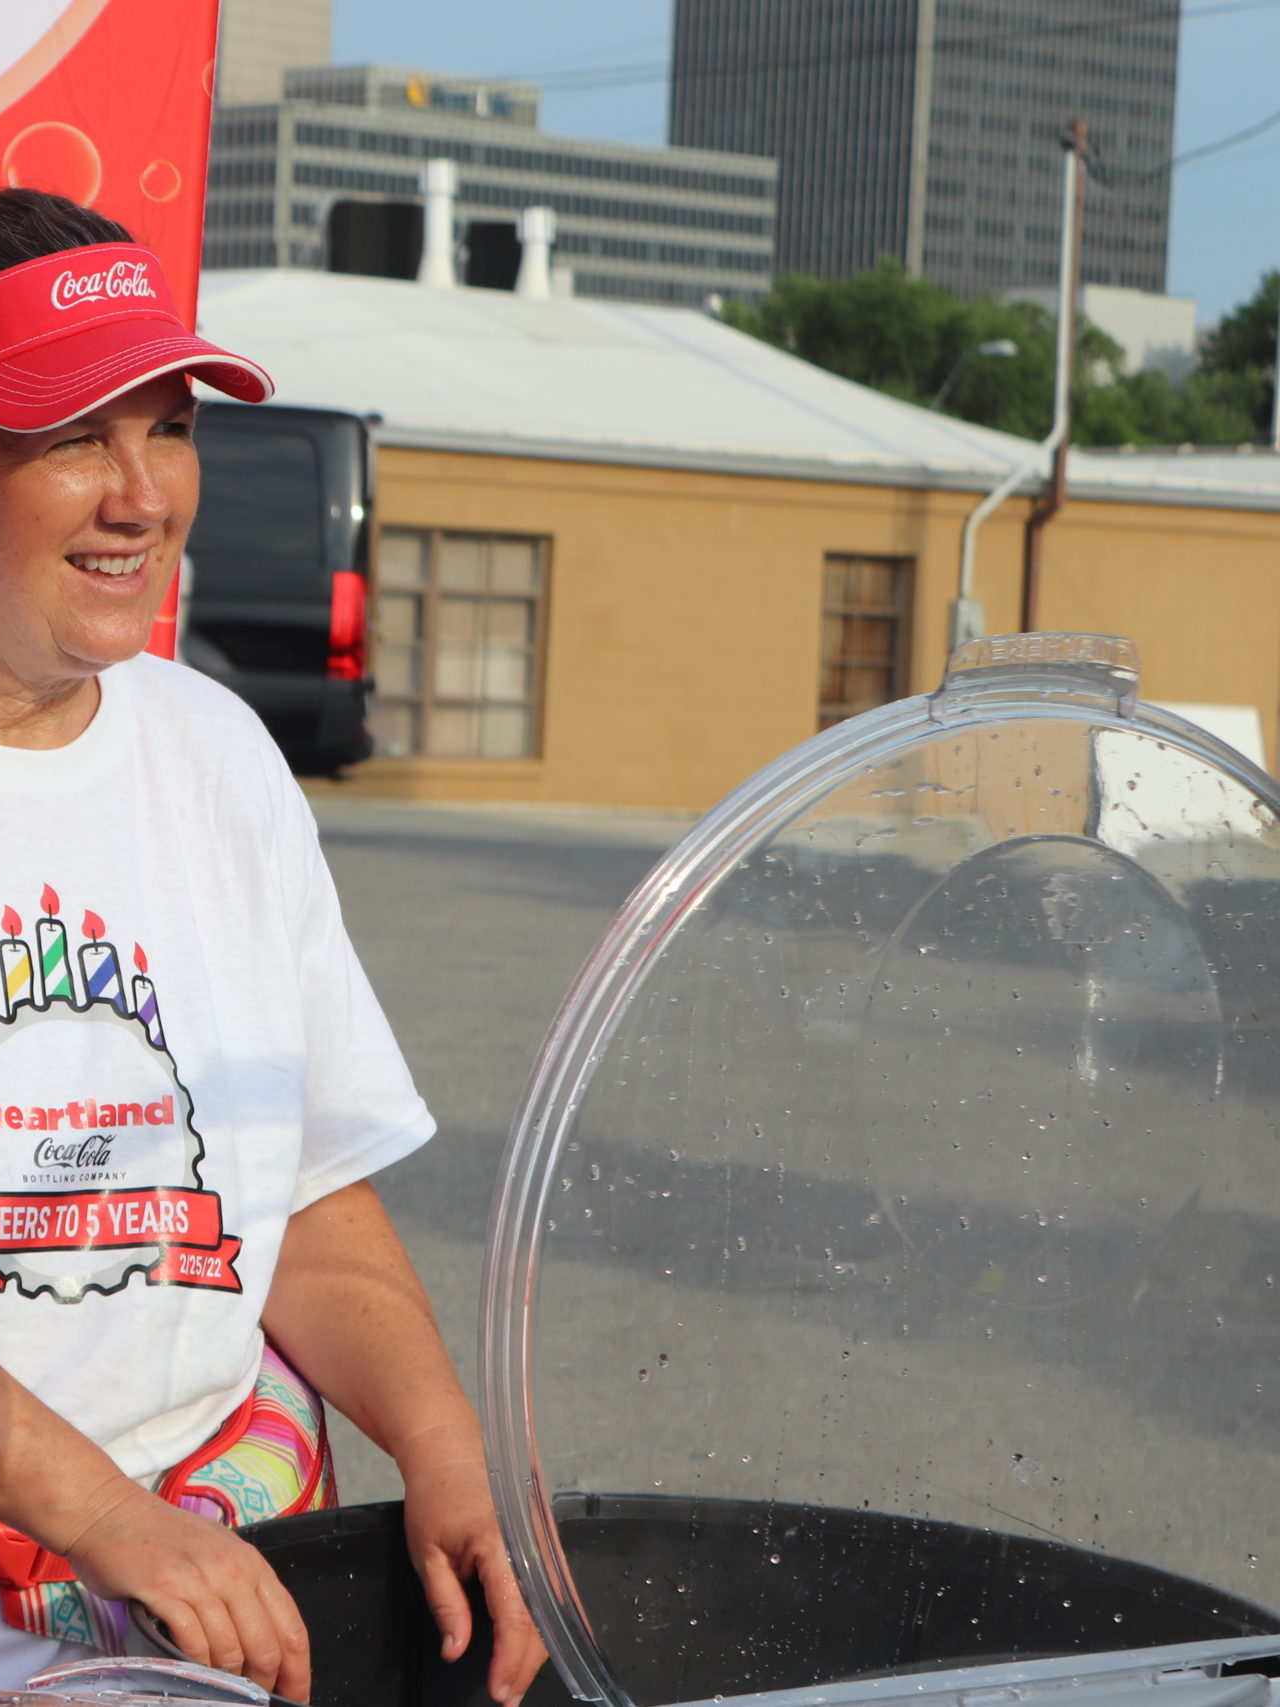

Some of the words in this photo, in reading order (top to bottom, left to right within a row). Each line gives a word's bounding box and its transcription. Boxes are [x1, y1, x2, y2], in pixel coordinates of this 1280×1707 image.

[51, 261, 150, 310] Coca-Cola
[33, 1134, 117, 1169] Coca-Cola
[22, 1174, 76, 1184] BOTTLING
[78, 1171, 128, 1182] COMPANY
[55, 1204, 80, 1238] TO
[86, 1202, 100, 1237] 5
[107, 1200, 190, 1236] YEARS
[179, 1254, 223, 1279] 2/25/22
